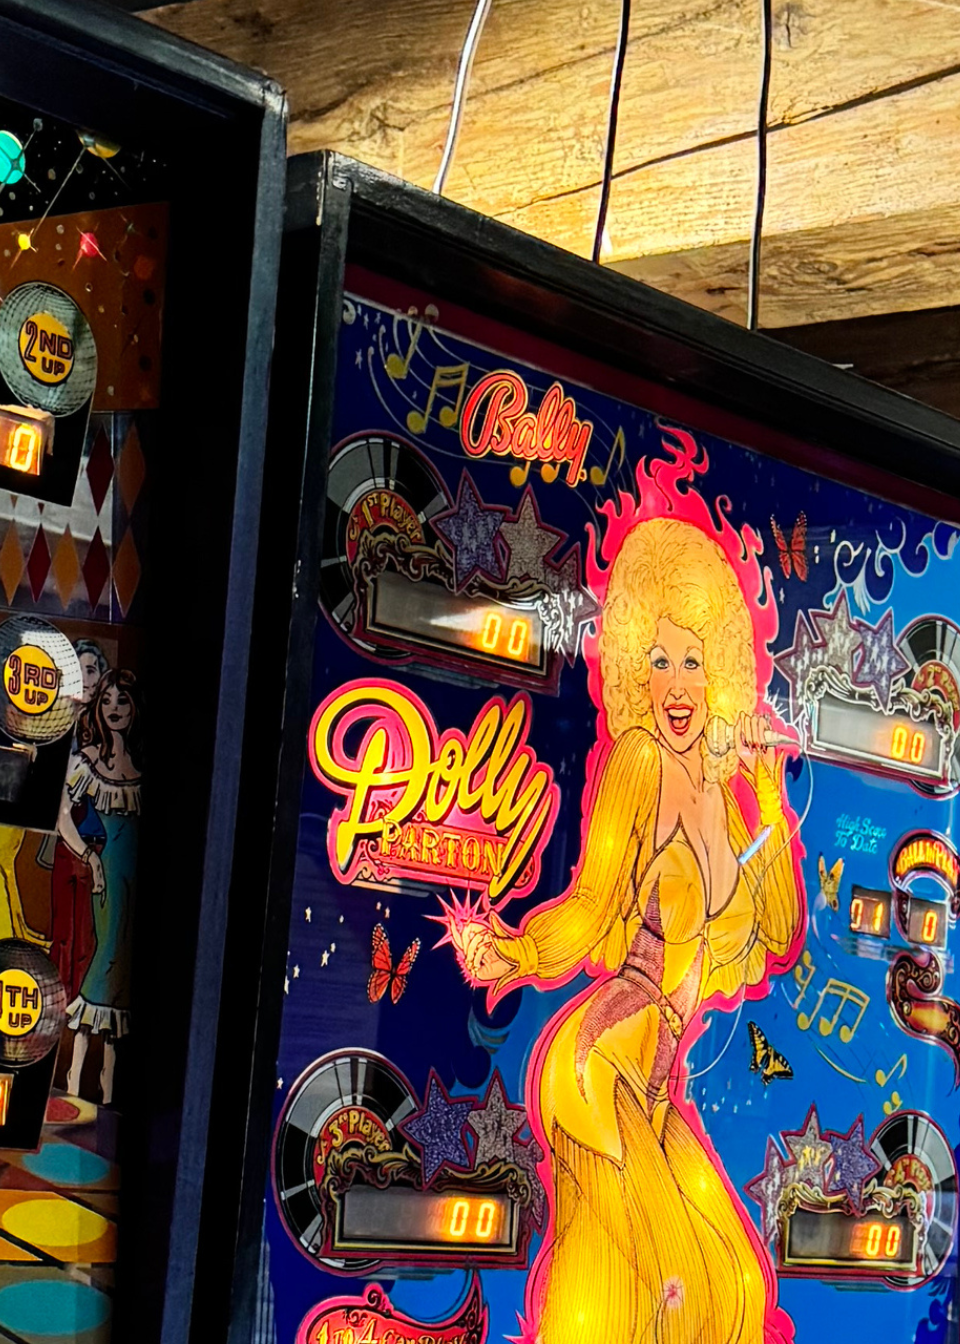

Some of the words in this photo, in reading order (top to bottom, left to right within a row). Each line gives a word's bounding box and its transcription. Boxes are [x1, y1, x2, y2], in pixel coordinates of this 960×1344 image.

[23, 320, 74, 372] 2ND
[41, 356, 64, 377] UP
[460, 369, 593, 488] Bally
[380, 492, 422, 541] Player
[482, 612, 528, 656] 00
[7, 648, 57, 693] 3RD
[24, 686, 47, 707] UP
[891, 725, 926, 764] 00
[312, 684, 553, 900] Dolly
[381, 817, 503, 878] PARTON
[8, 1013, 31, 1029] UP
[348, 1110, 391, 1152] Player
[449, 1200, 495, 1238] 00
[865, 1224, 901, 1257] 00
